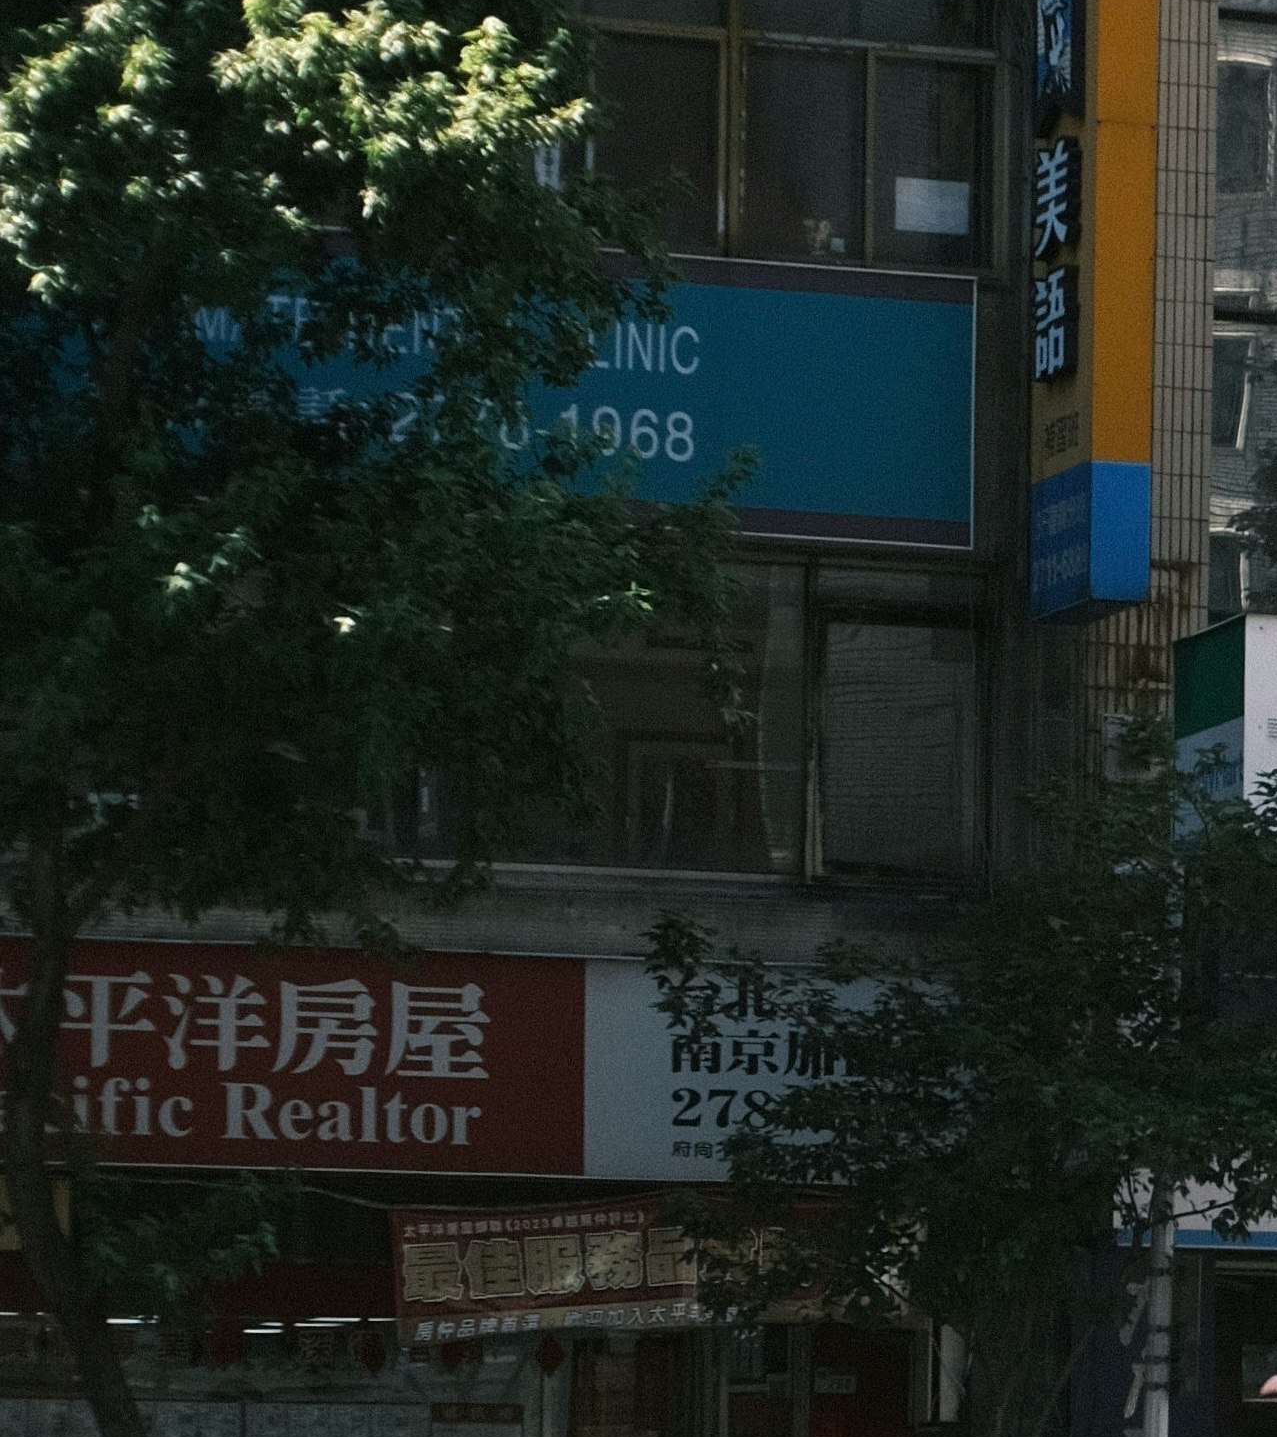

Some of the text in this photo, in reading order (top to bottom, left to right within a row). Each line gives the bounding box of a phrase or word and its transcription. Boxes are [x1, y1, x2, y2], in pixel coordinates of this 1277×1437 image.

[1034, 145, 1071, 381] 美語
[585, 320, 700, 376] LINIC
[0, 970, 491, 1080] 平洋房屋
[46, 1075, 482, 1147] ific Realtor
